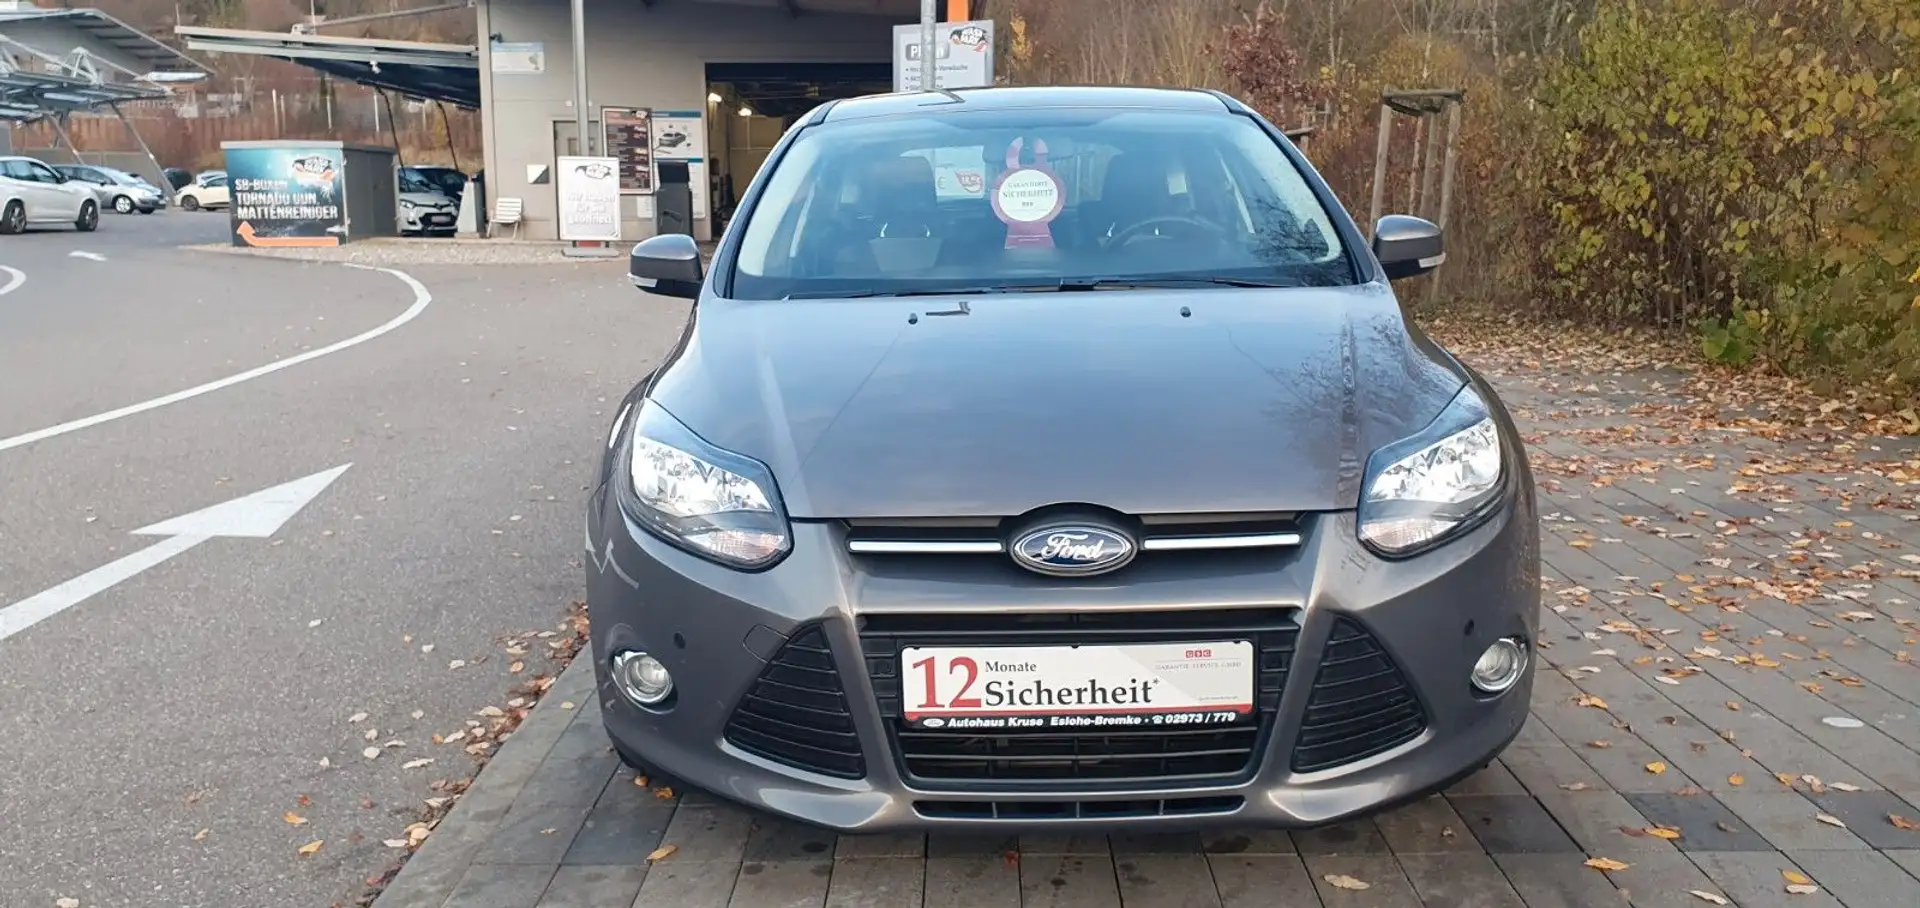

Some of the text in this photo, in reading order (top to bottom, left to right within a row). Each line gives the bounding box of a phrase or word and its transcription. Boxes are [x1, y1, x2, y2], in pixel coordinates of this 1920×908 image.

[236, 191, 290, 205] TORNADO
[238, 206, 339, 219] MATTENREINIGER
[1041, 533, 1104, 560] Ford
[912, 656, 1037, 708] 12 Monate
[948, 717, 1005, 728] Autohaus
[1008, 717, 1044, 727] Kruse
[1050, 715, 1142, 726] Eslohe-Bremke
[1165, 713, 1200, 724] 02973
[1214, 712, 1236, 722] 779
